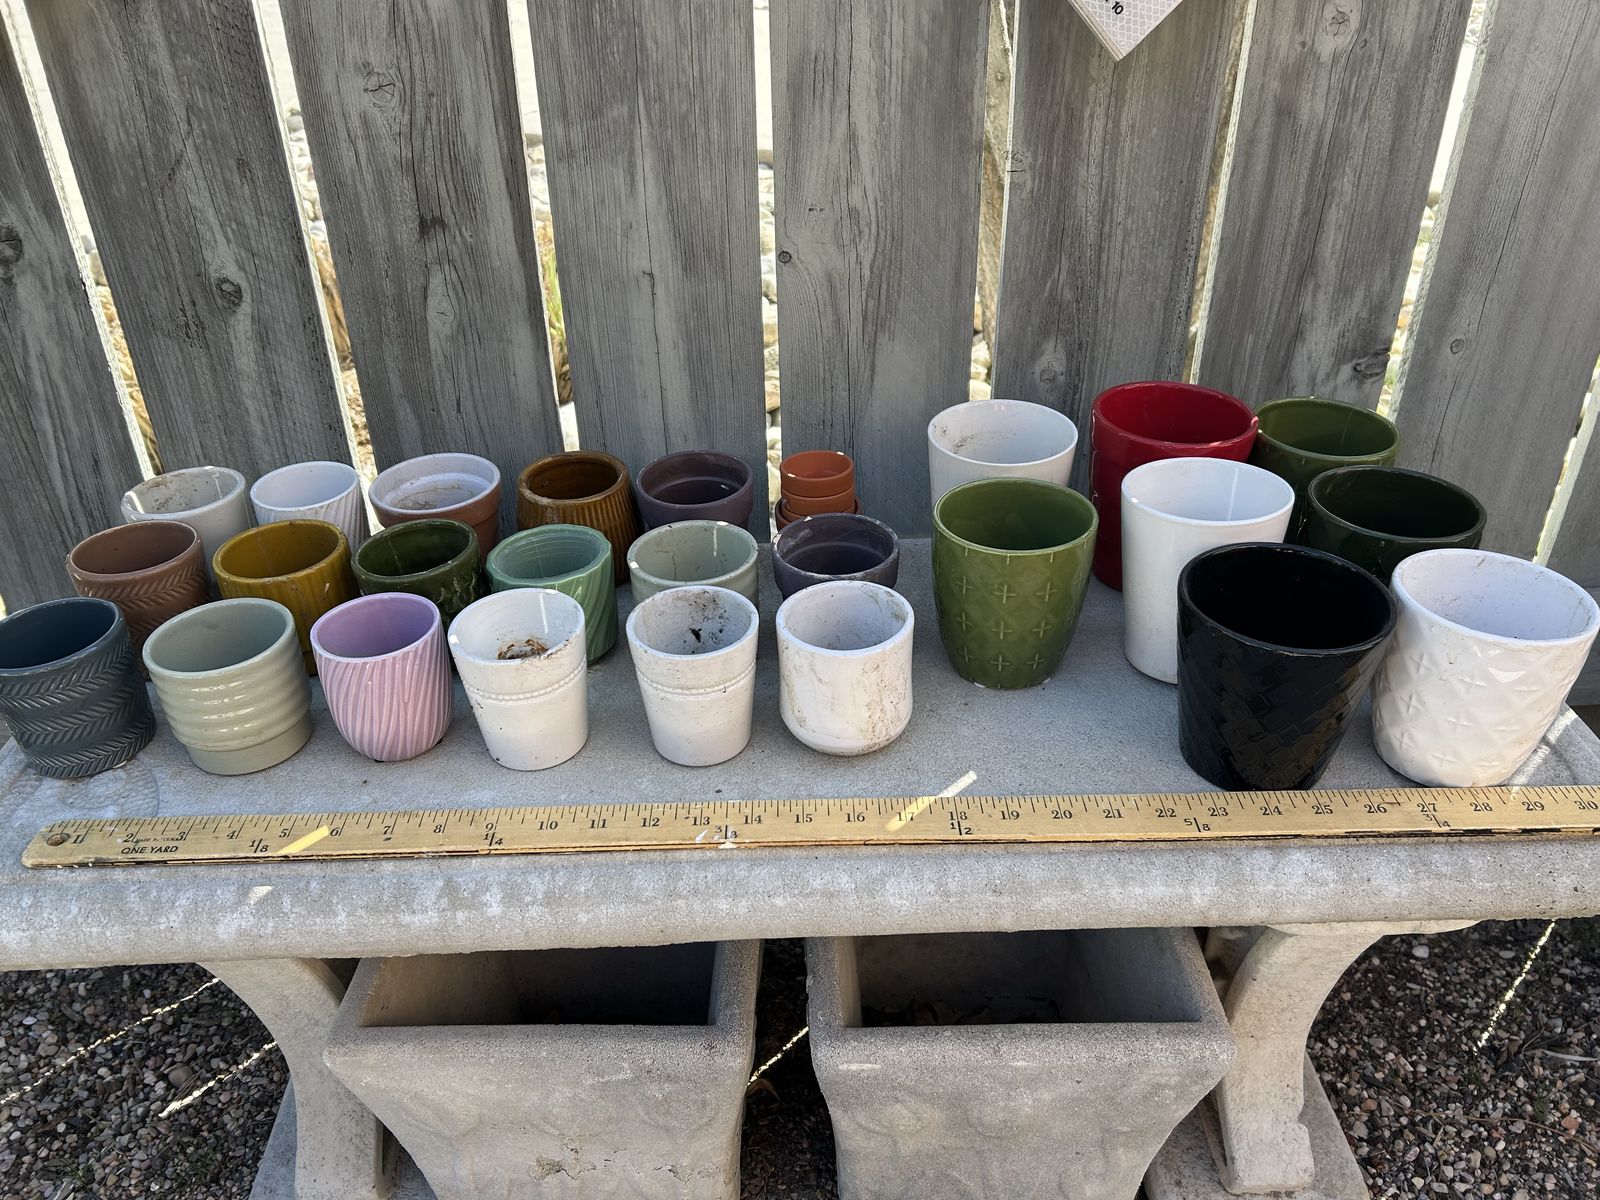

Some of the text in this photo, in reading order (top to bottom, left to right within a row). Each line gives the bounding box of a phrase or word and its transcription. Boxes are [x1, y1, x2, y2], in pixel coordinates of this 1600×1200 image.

[1111, 1, 1124, 15] 10
[122, 833, 134, 843] 2
[177, 831, 186, 841] 3
[226, 830, 236, 839] 4
[279, 828, 288, 838] 5
[330, 827, 340, 836] 6
[383, 826, 392, 835] 7
[433, 824, 443, 834] 8
[485, 822, 494, 832] 9
[538, 820, 558, 830] 10
[588, 819, 608, 829] 11
[641, 817, 660, 827] 12
[691, 816, 711, 826] 13
[743, 815, 763, 825] 14
[794, 813, 813, 823] 15
[845, 812, 866, 822] 16
[896, 812, 915, 822] 17
[949, 811, 968, 821] 18
[1000, 810, 1020, 820] 19
[1051, 809, 1073, 819] 20
[1103, 808, 1124, 819] 21
[1155, 807, 1177, 818] 22
[1207, 806, 1229, 817] 23
[1260, 806, 1283, 816] 24
[1312, 804, 1334, 815] 25
[1363, 803, 1387, 814] 26
[1417, 802, 1438, 813] 27
[1469, 801, 1493, 812] 28
[1521, 801, 1545, 811] 29
[1574, 800, 1599, 810] 30
